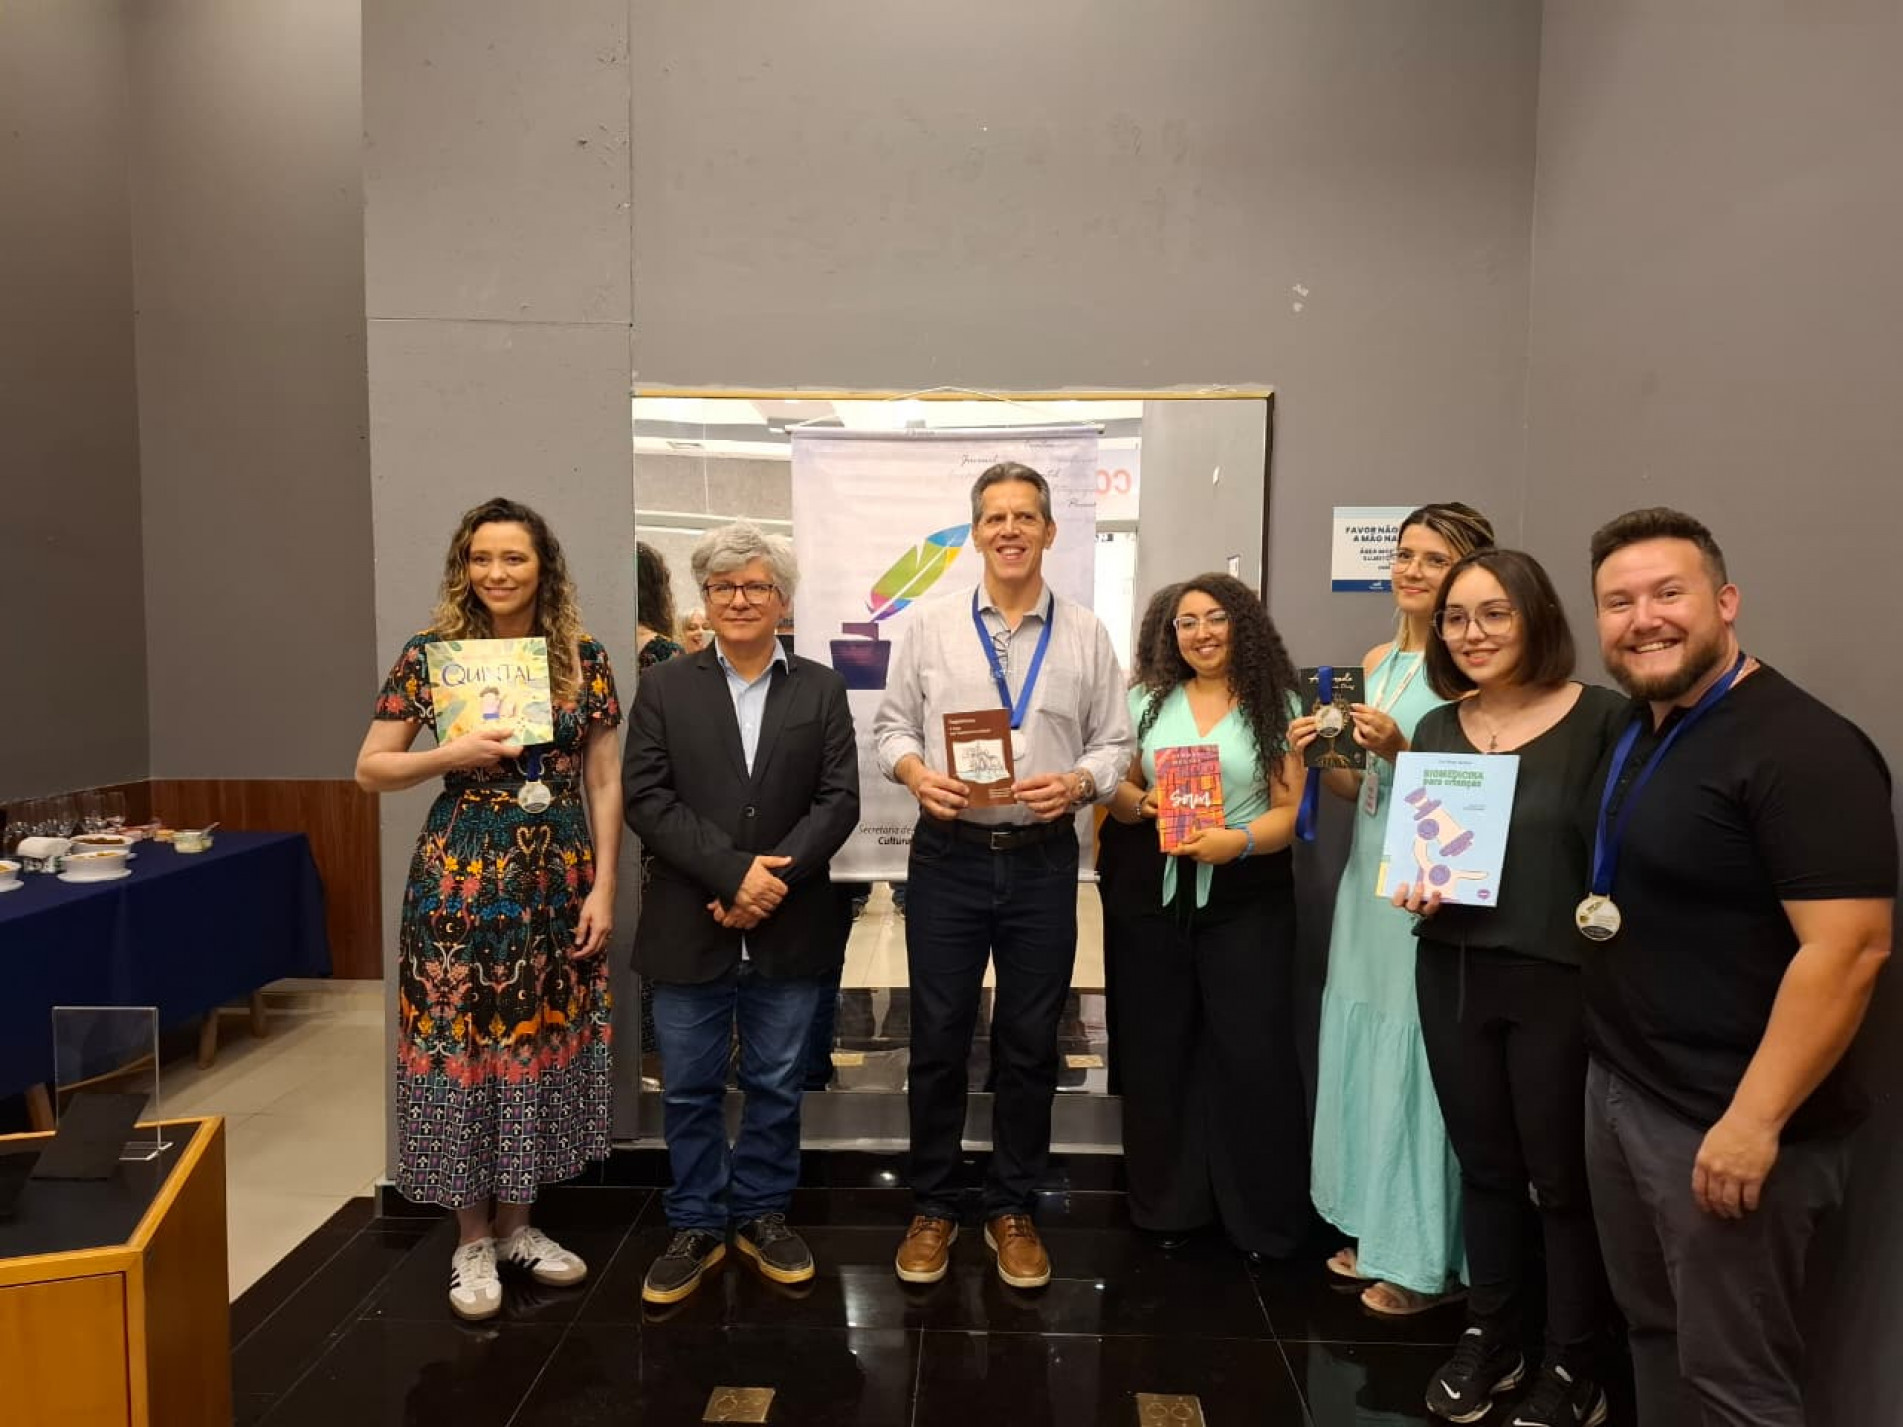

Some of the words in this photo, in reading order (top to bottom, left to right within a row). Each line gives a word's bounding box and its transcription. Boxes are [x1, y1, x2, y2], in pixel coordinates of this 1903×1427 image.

[1345, 526, 1376, 534] FAVOR
[1377, 524, 1399, 533] NÃO
[1353, 534, 1360, 542] A
[1361, 534, 1383, 542] MÃO
[442, 664, 536, 688] QUINTAL
